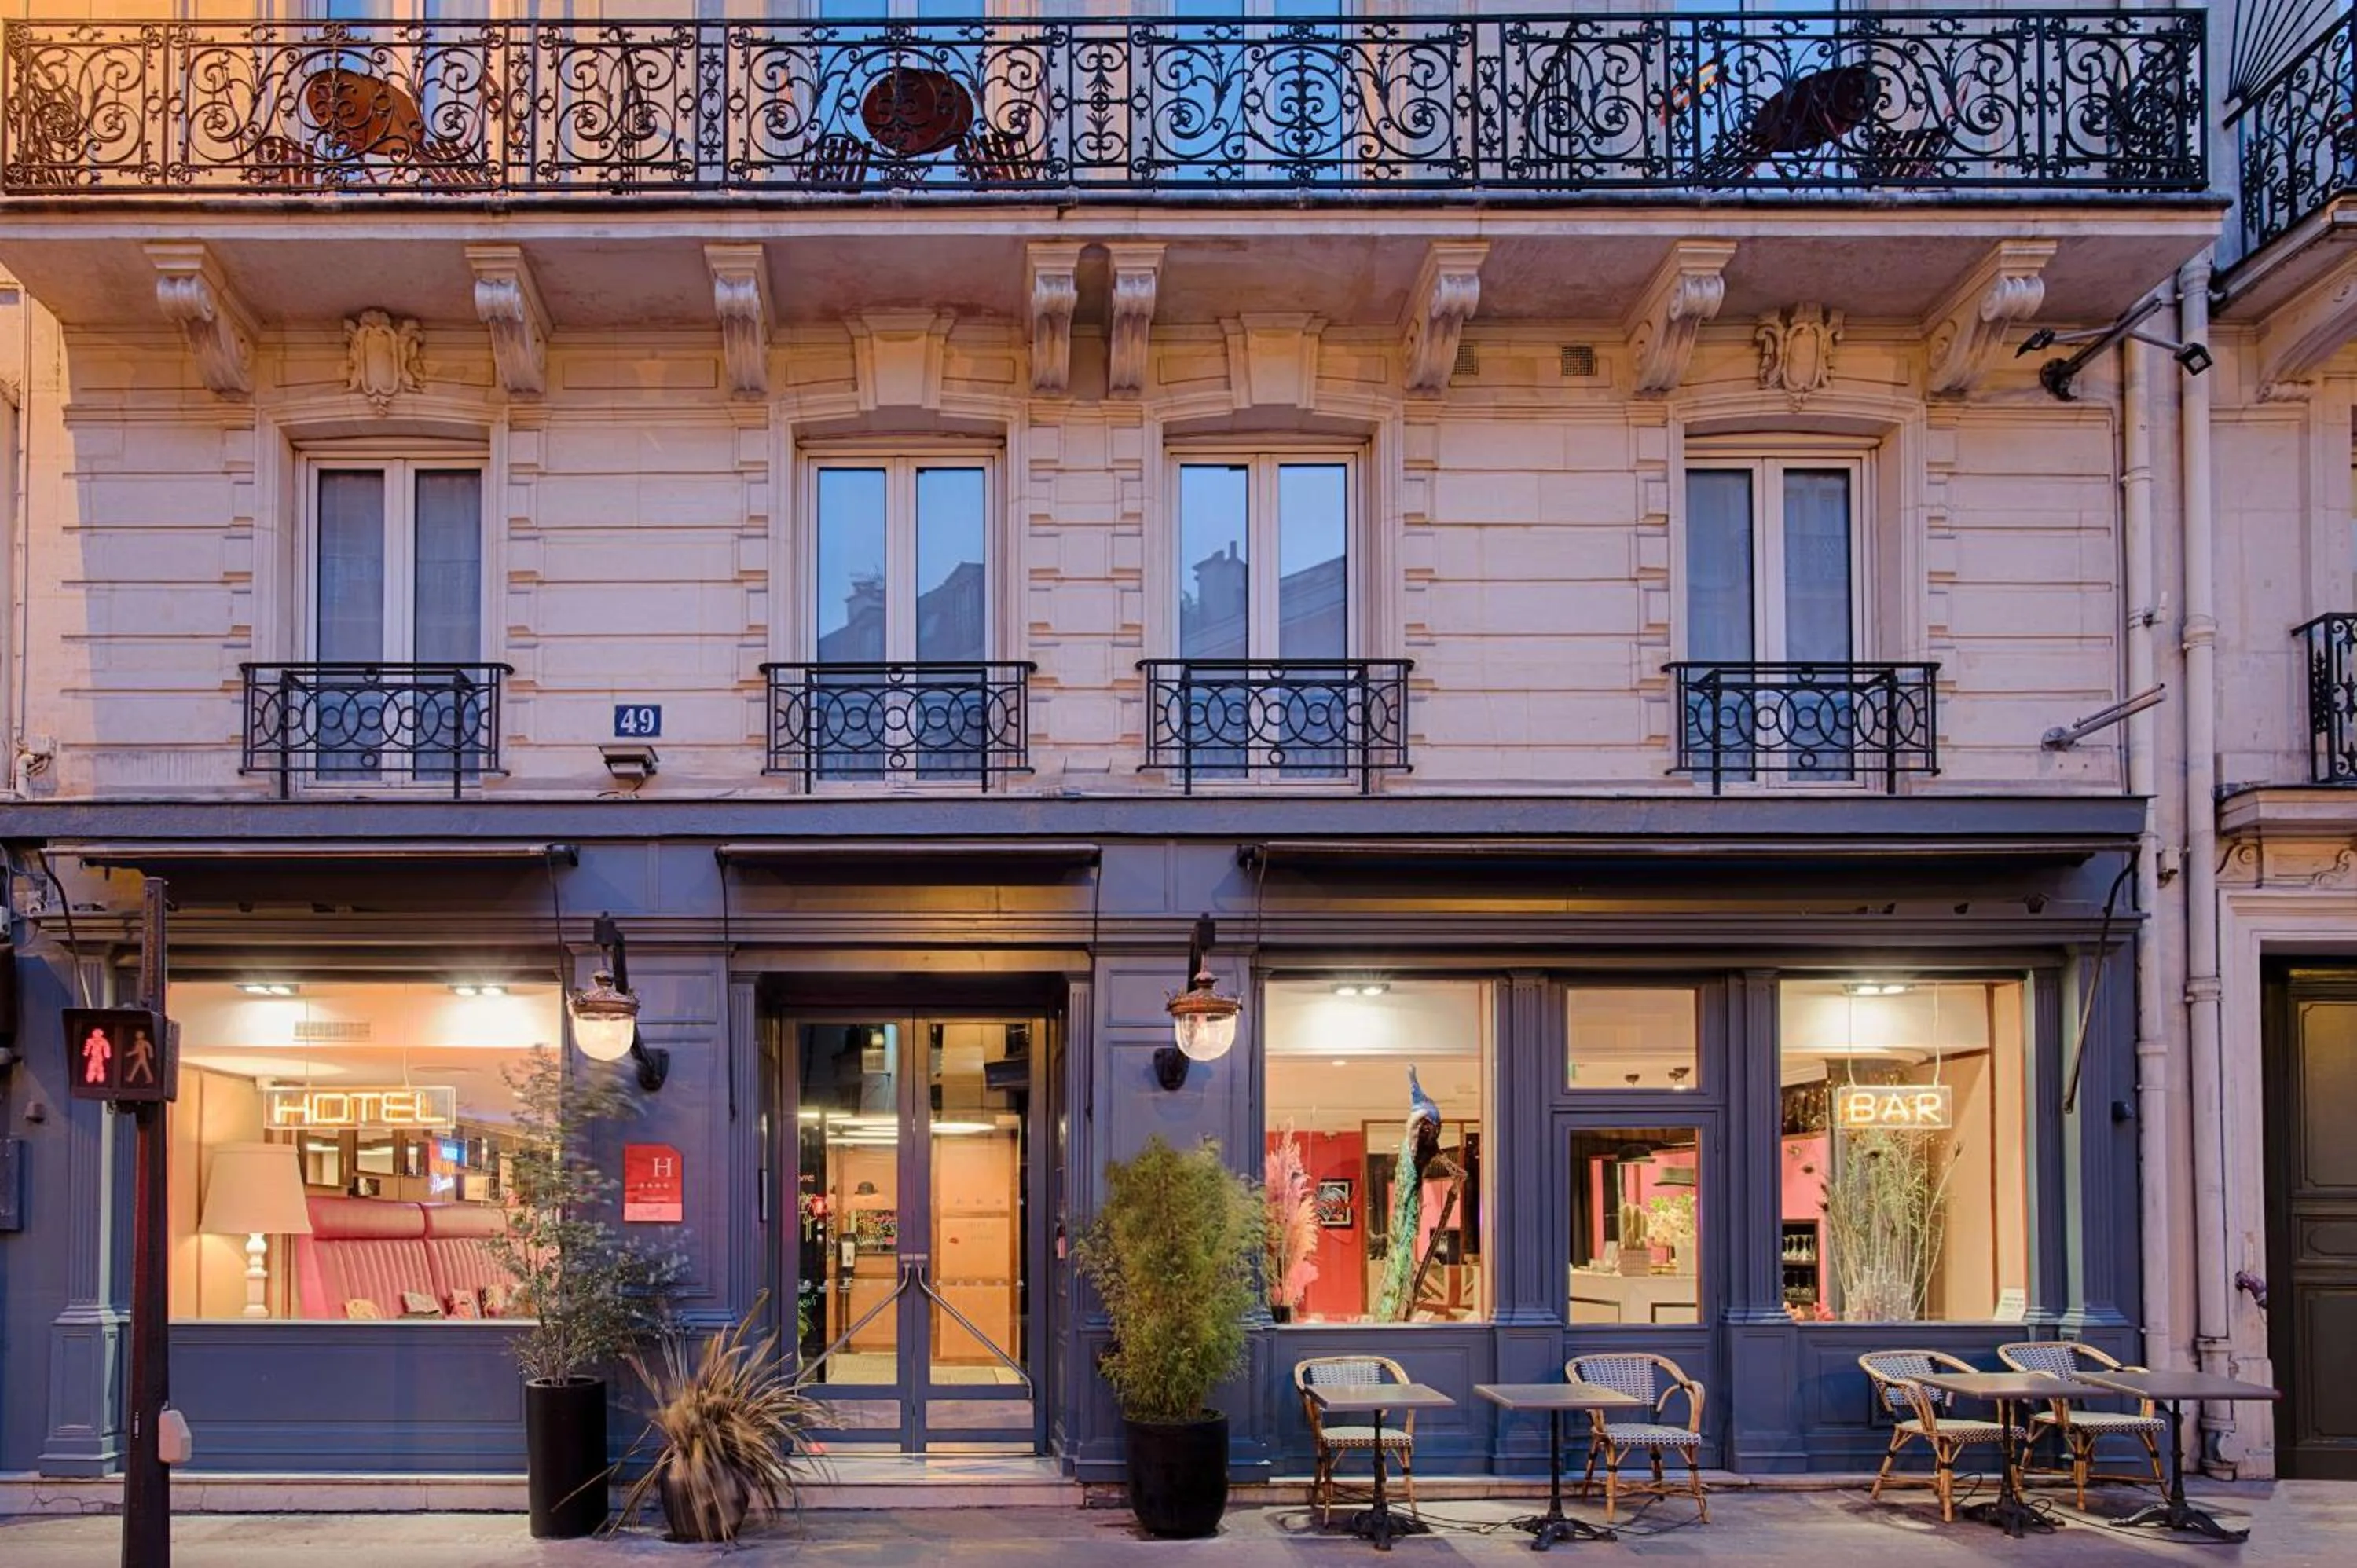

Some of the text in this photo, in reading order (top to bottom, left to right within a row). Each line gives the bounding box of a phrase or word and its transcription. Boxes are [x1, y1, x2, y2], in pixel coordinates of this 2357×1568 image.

[620, 708, 655, 734] 49
[273, 1092, 447, 1124] HOTEL
[1849, 1092, 1942, 1123] BAR
[653, 1157, 672, 1178] H
